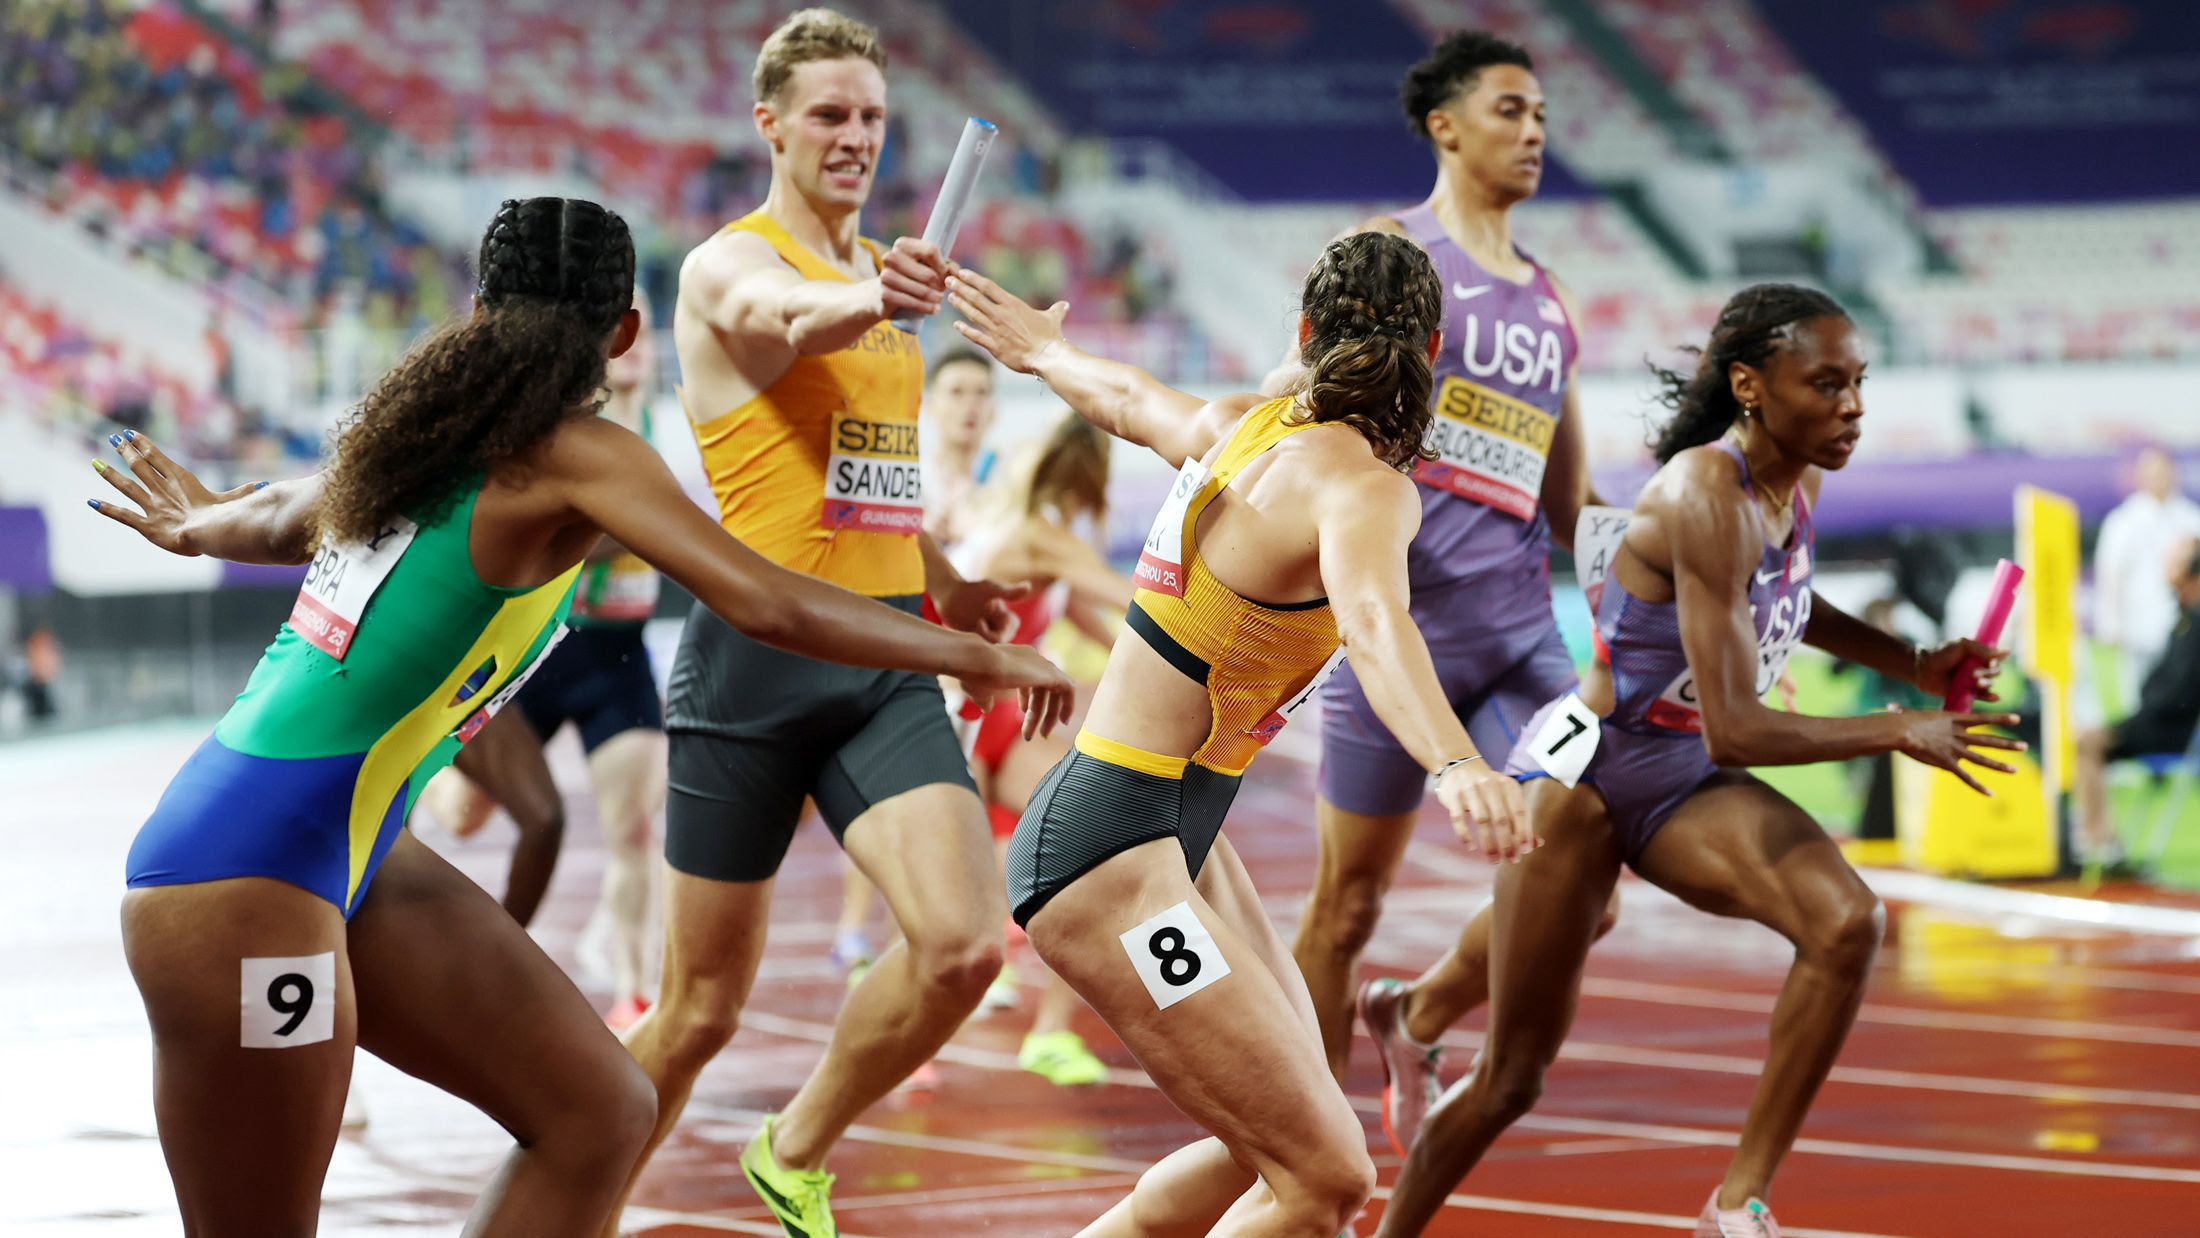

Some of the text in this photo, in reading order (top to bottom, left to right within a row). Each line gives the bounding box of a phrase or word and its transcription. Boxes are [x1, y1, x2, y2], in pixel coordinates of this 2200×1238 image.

[1463, 313, 1563, 394] USA
[1445, 385, 1547, 449] SEIKO
[305, 544, 348, 603] BRA
[1163, 570, 1177, 588] 25
[327, 625, 348, 649] 25
[1547, 713, 1588, 756] 7
[1149, 926, 1202, 987] 8
[267, 972, 314, 1037] 9
